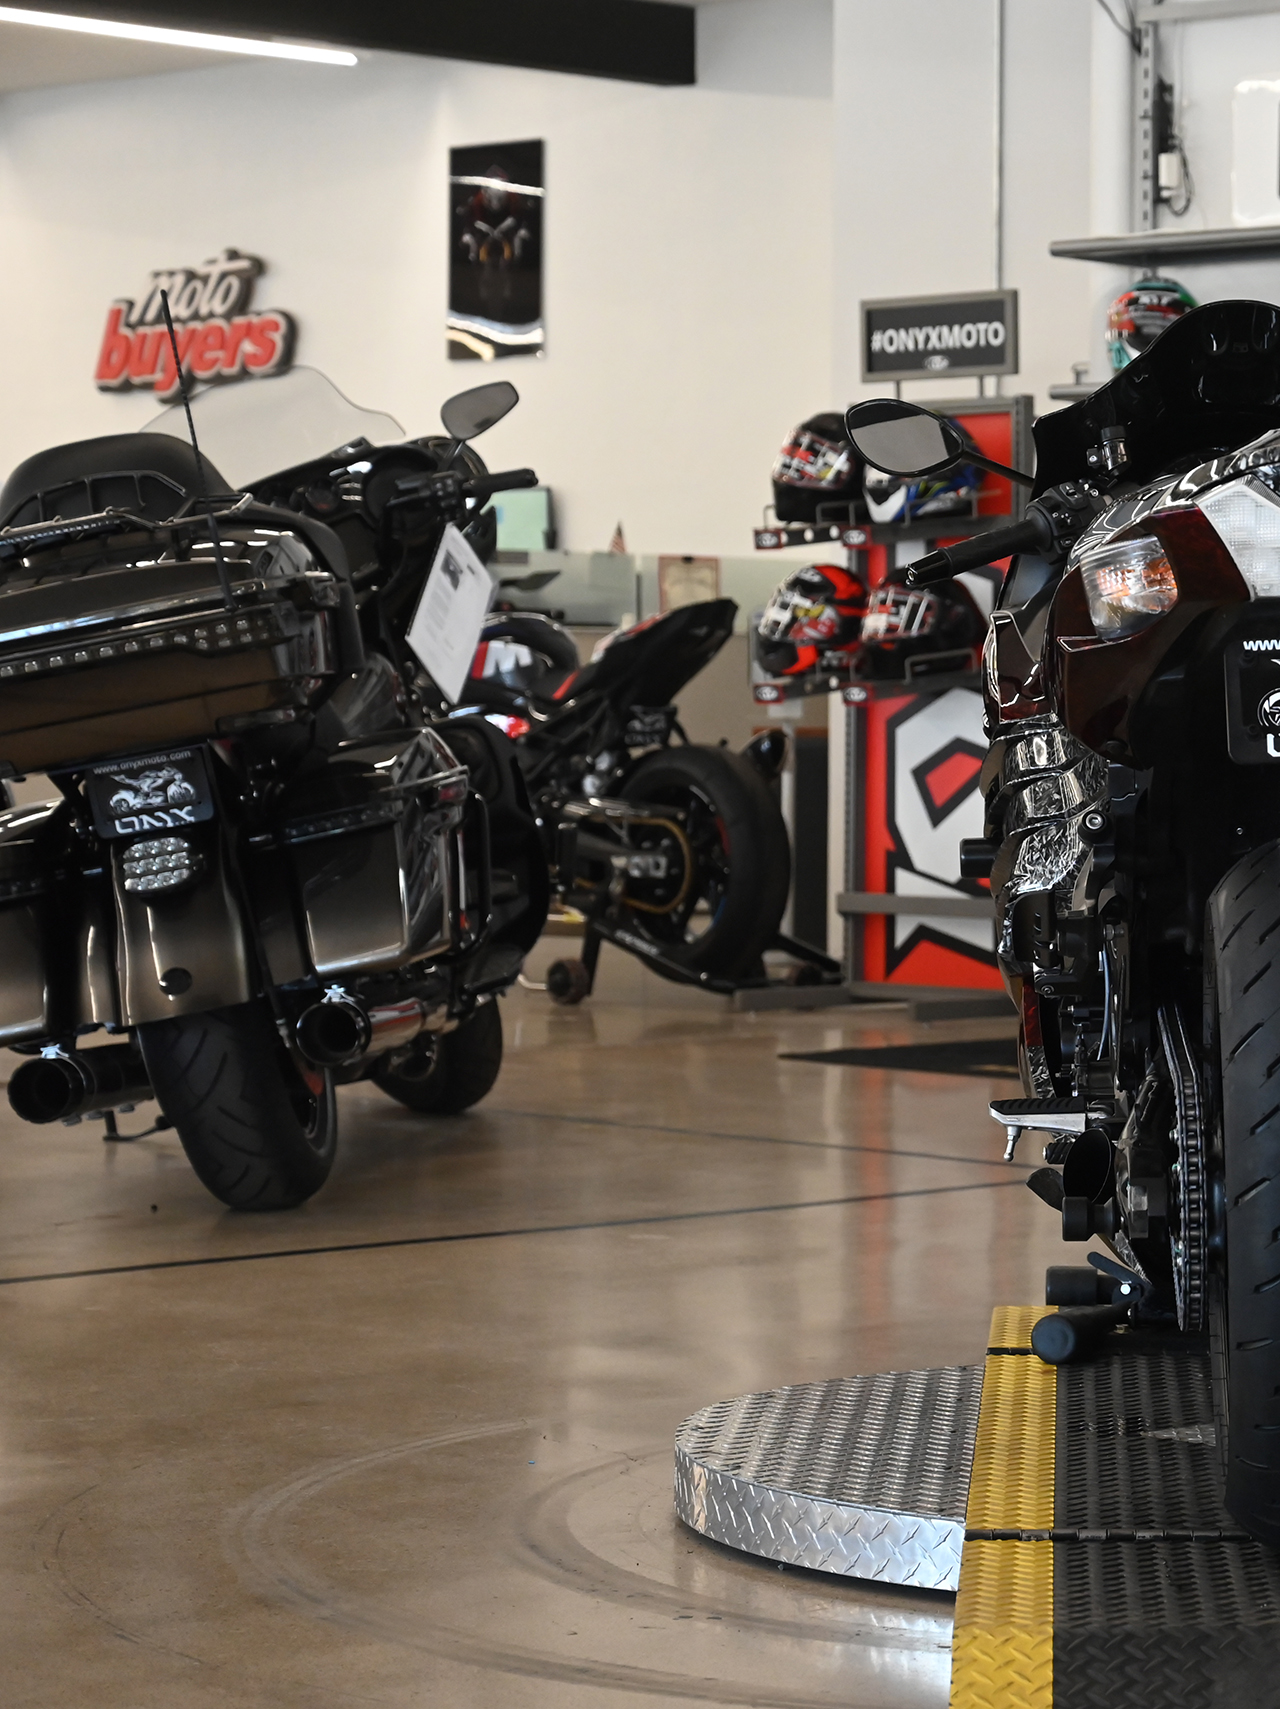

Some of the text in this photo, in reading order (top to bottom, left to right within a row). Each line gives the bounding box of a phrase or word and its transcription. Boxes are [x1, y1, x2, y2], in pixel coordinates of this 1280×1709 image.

[95, 305, 282, 394] buyers
[871, 321, 1005, 353] #ONYXMOTO
[93, 750, 192, 775] www.onyxmoto.com
[114, 805, 195, 834] ONYX
